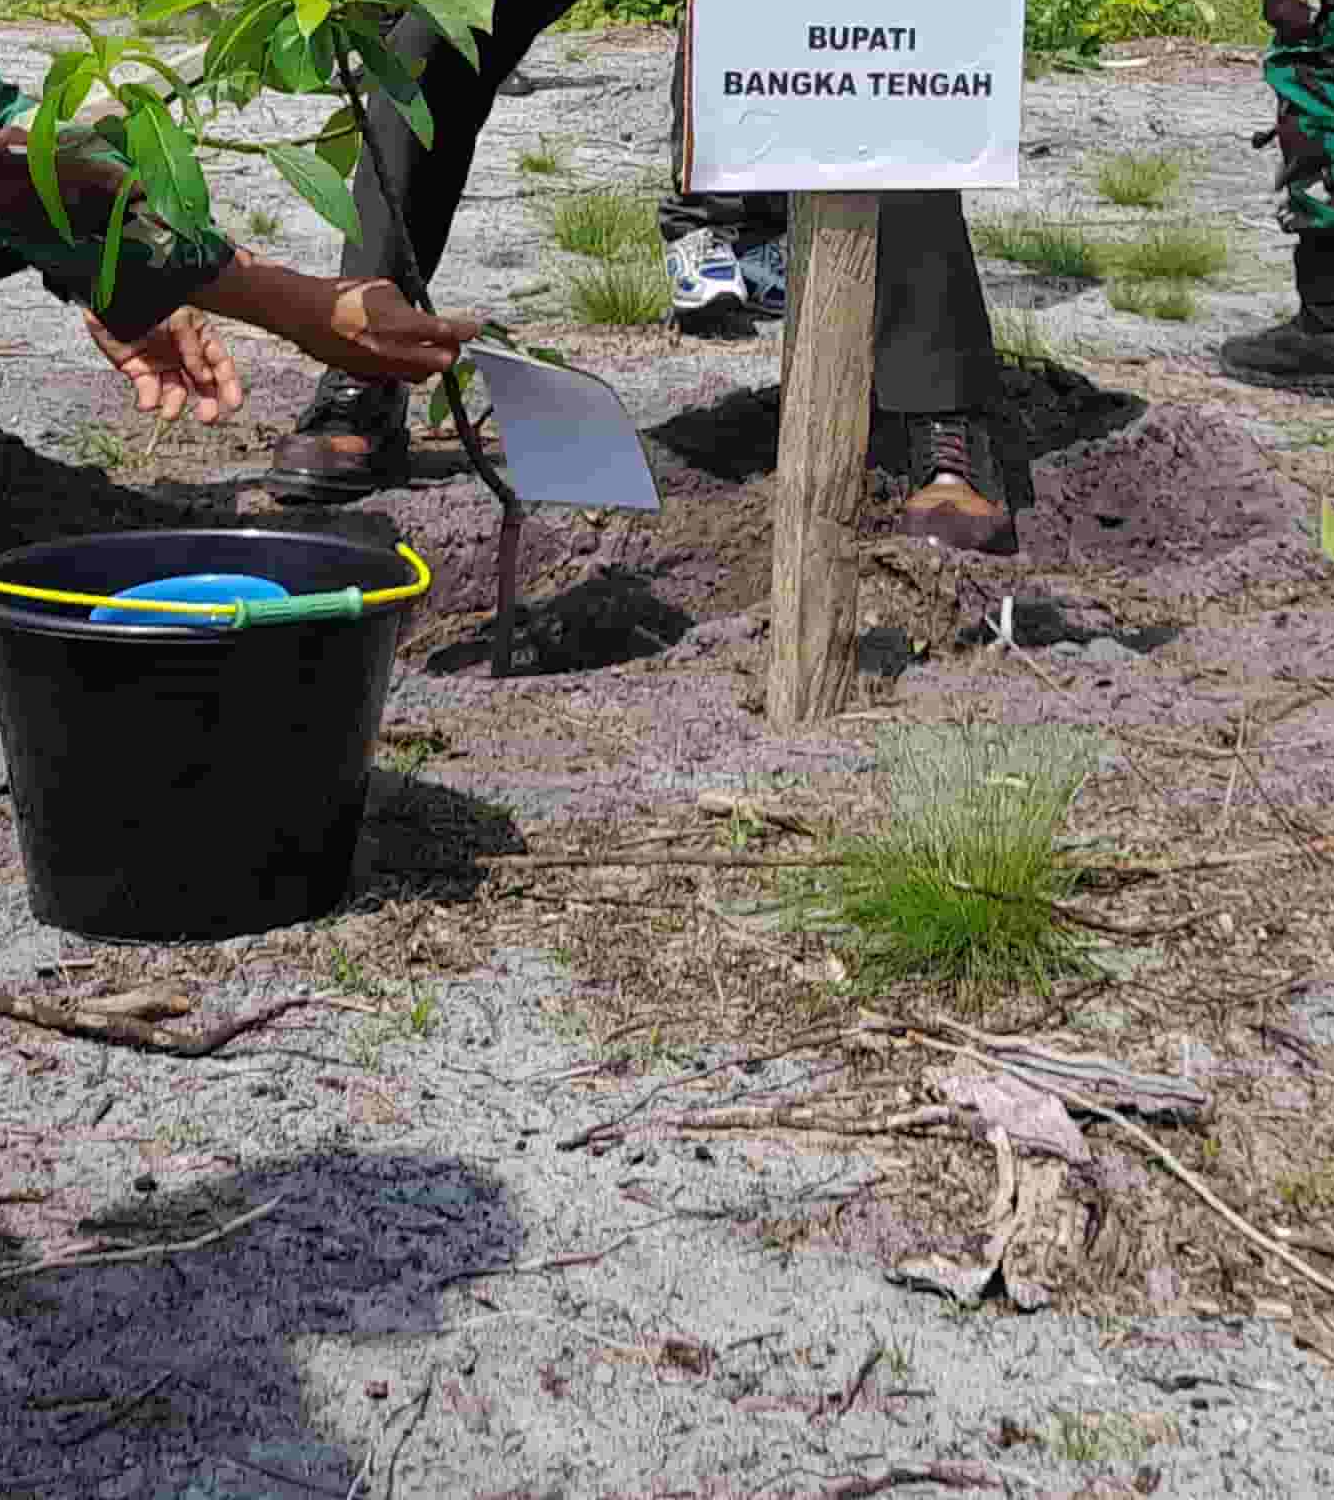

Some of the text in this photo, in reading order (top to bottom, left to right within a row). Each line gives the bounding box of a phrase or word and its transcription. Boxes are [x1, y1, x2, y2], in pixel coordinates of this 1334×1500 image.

[807, 25, 916, 51] BUPATI
[722, 71, 993, 97] BANGKA TENGAH
